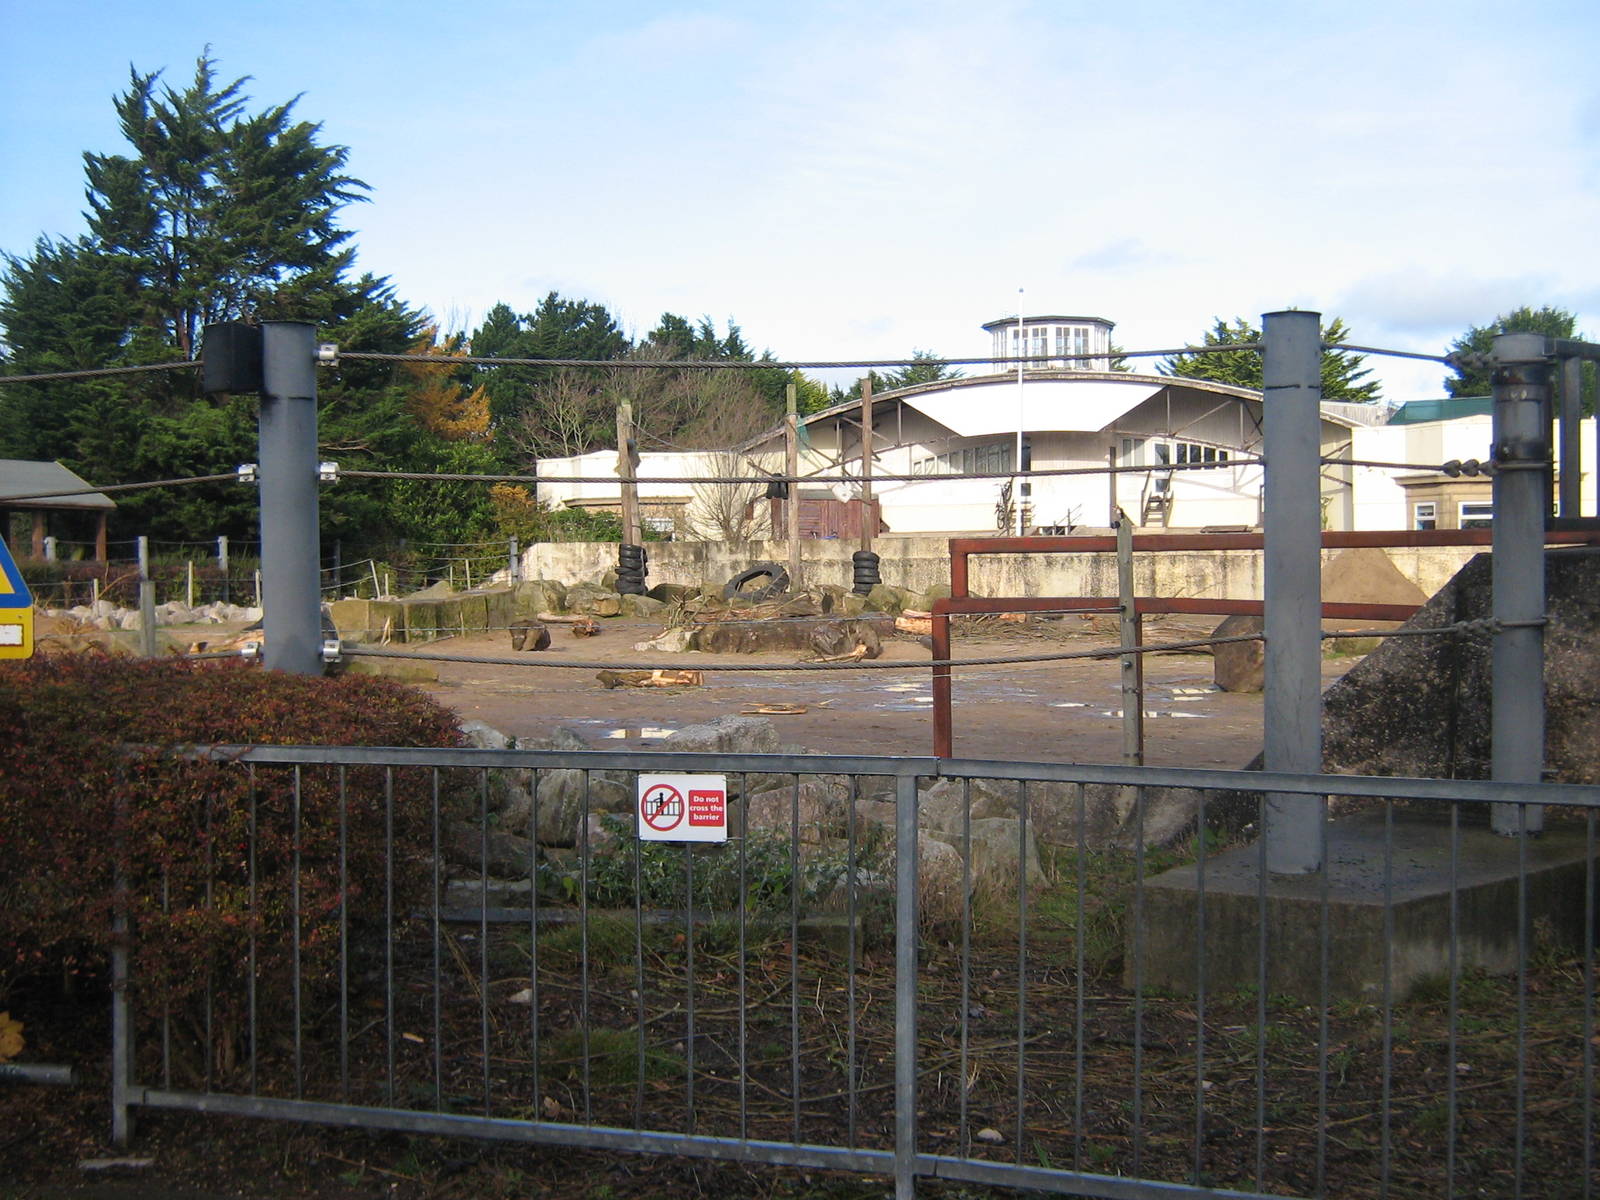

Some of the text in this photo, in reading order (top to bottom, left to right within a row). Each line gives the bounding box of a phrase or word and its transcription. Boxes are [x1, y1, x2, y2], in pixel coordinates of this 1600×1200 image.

[693, 795, 704, 803] Do
[710, 804, 723, 812] the
[693, 813, 720, 821] barrier
